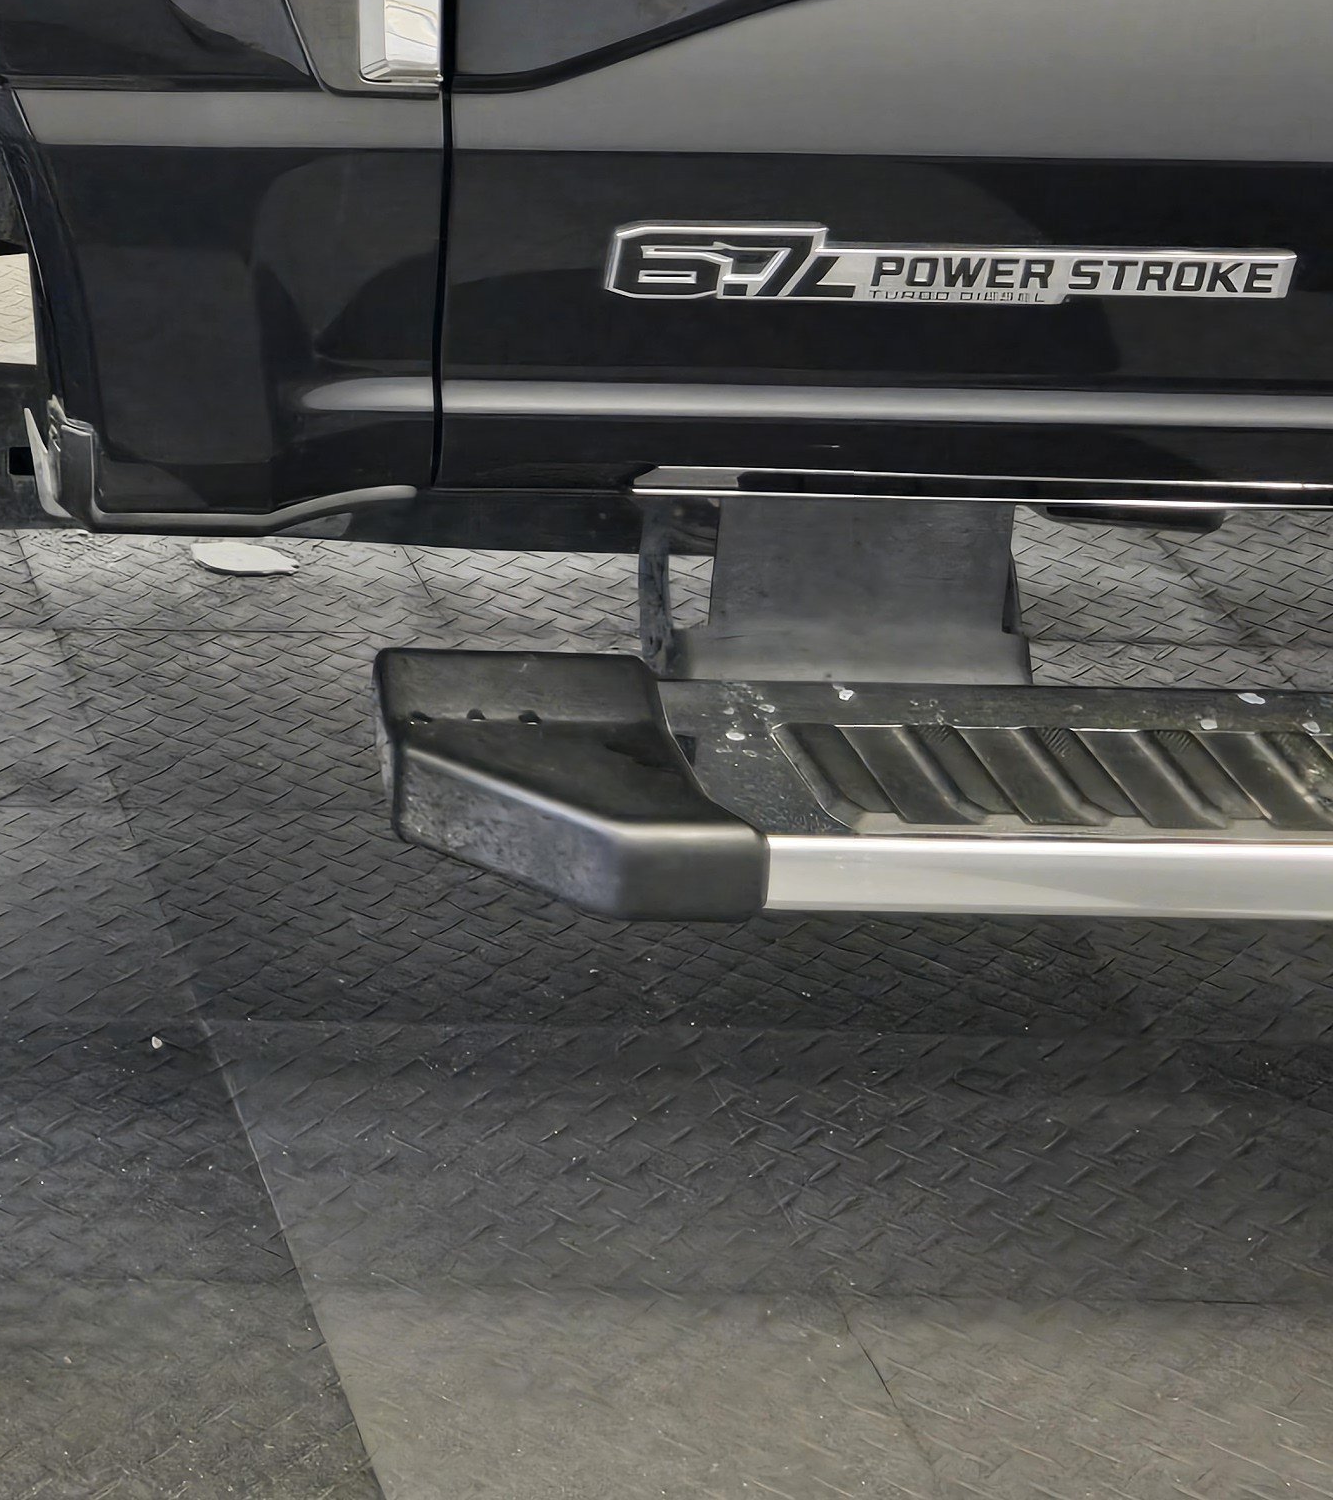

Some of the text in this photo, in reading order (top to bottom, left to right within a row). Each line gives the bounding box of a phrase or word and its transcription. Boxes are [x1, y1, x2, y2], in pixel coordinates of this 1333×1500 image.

[606, 222, 1280, 300] 6.7L POWER STROKE
[959, 292, 1045, 303] DIL
